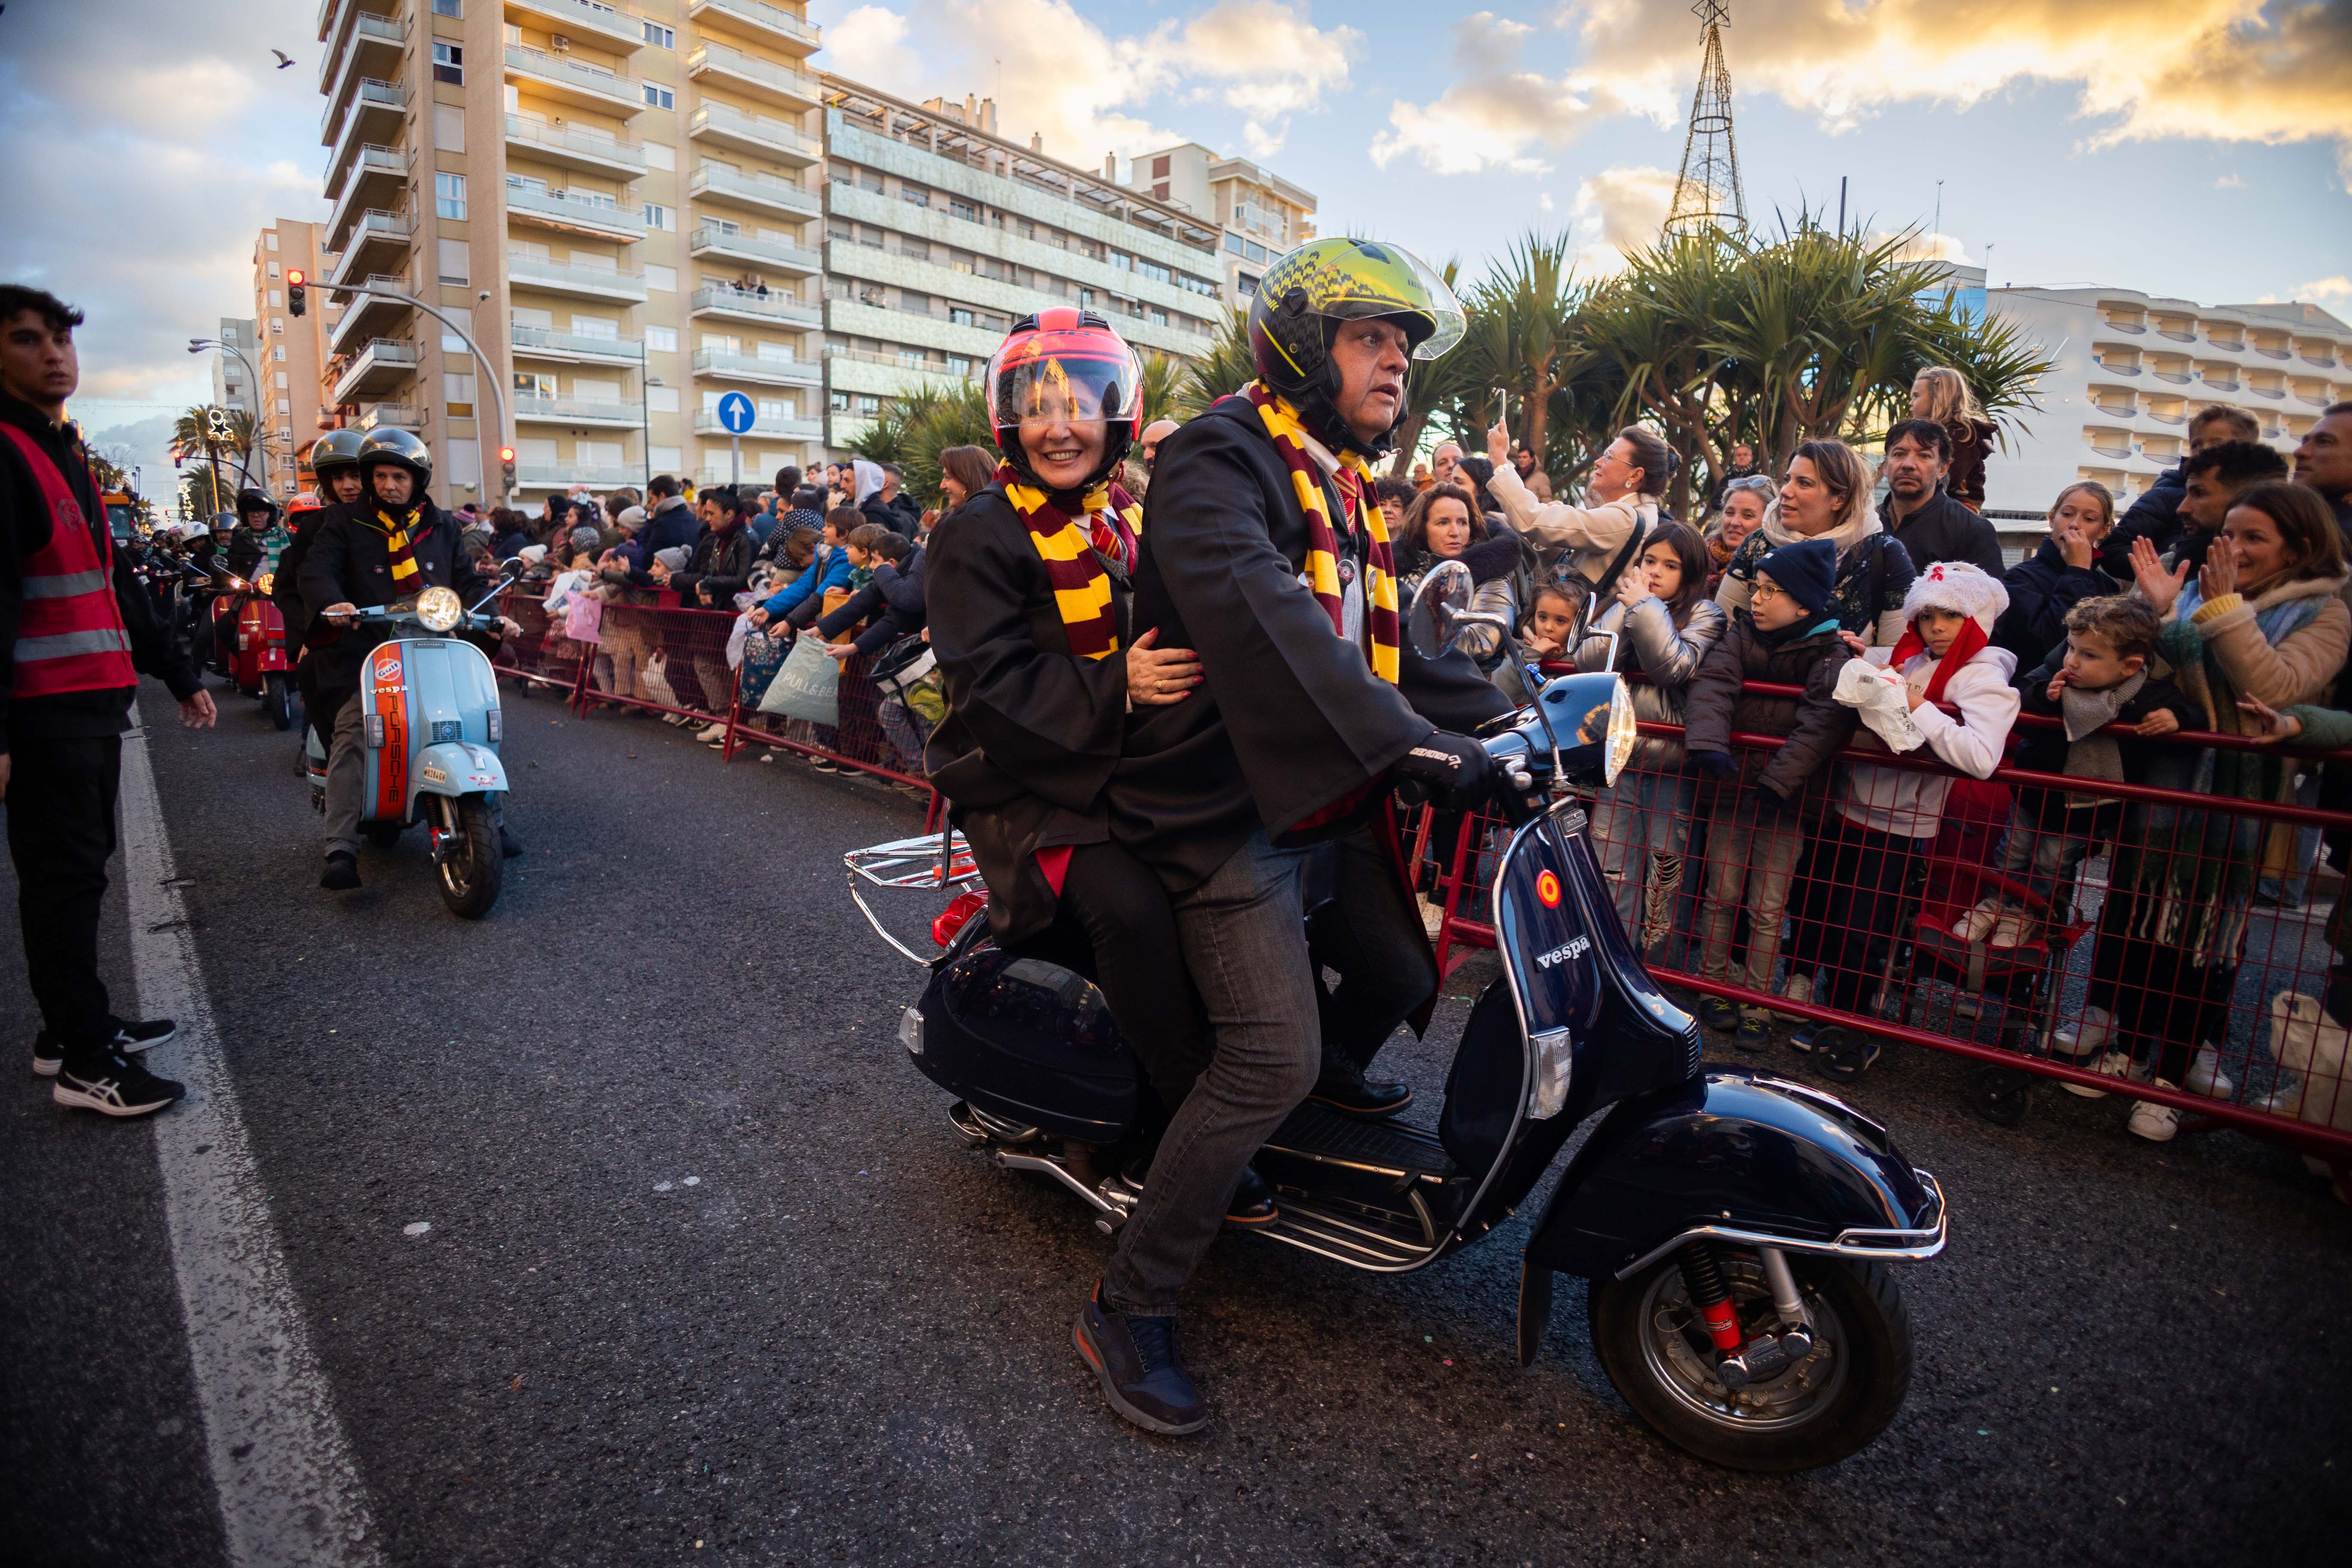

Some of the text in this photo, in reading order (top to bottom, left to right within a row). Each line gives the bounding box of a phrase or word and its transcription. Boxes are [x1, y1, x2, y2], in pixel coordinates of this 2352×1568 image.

[378, 662, 398, 677] Gulf
[370, 685, 408, 695] vespa
[388, 695, 401, 803] PORSCHE
[1537, 937, 1590, 968] vespa
